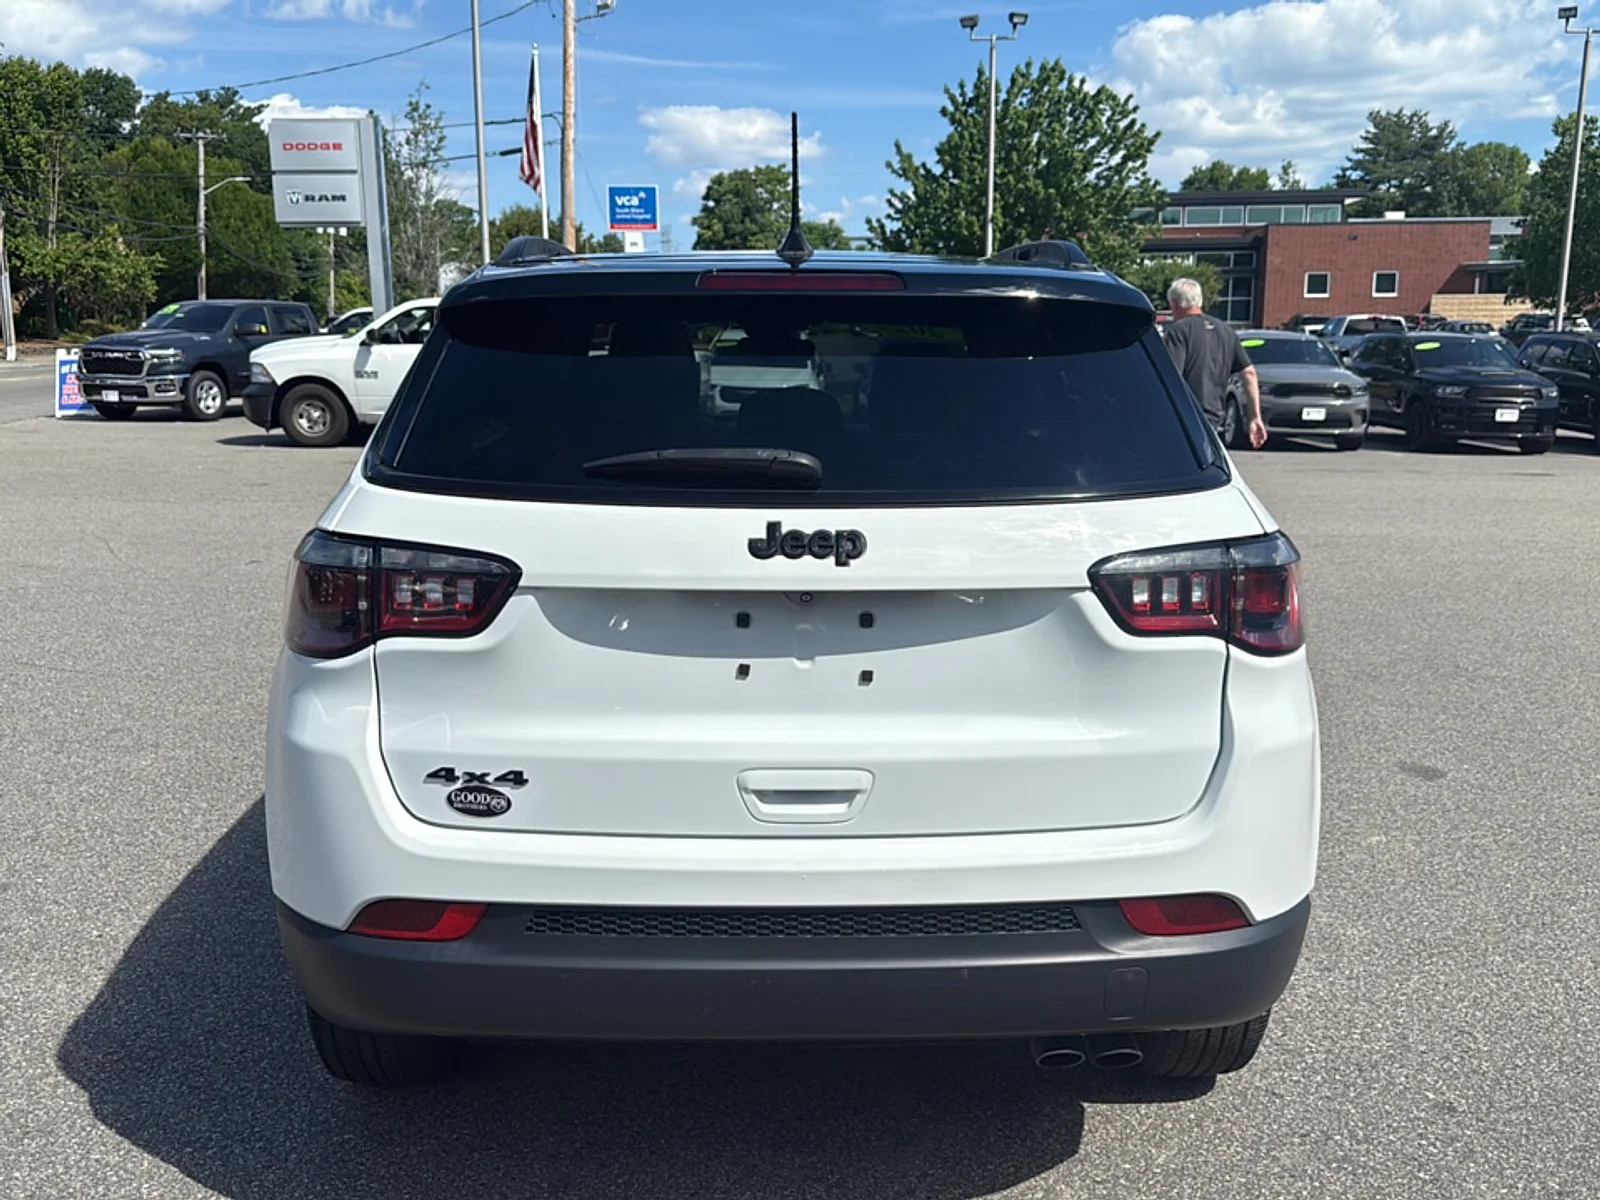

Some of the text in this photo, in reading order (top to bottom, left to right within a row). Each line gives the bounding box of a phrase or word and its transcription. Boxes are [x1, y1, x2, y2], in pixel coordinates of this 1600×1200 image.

[283, 143, 343, 151] DODGE
[304, 194, 346, 202] RAM
[615, 195, 639, 206] vca
[747, 520, 867, 567] Jeep
[424, 766, 529, 788] 4x4
[451, 791, 490, 804] GOOD
